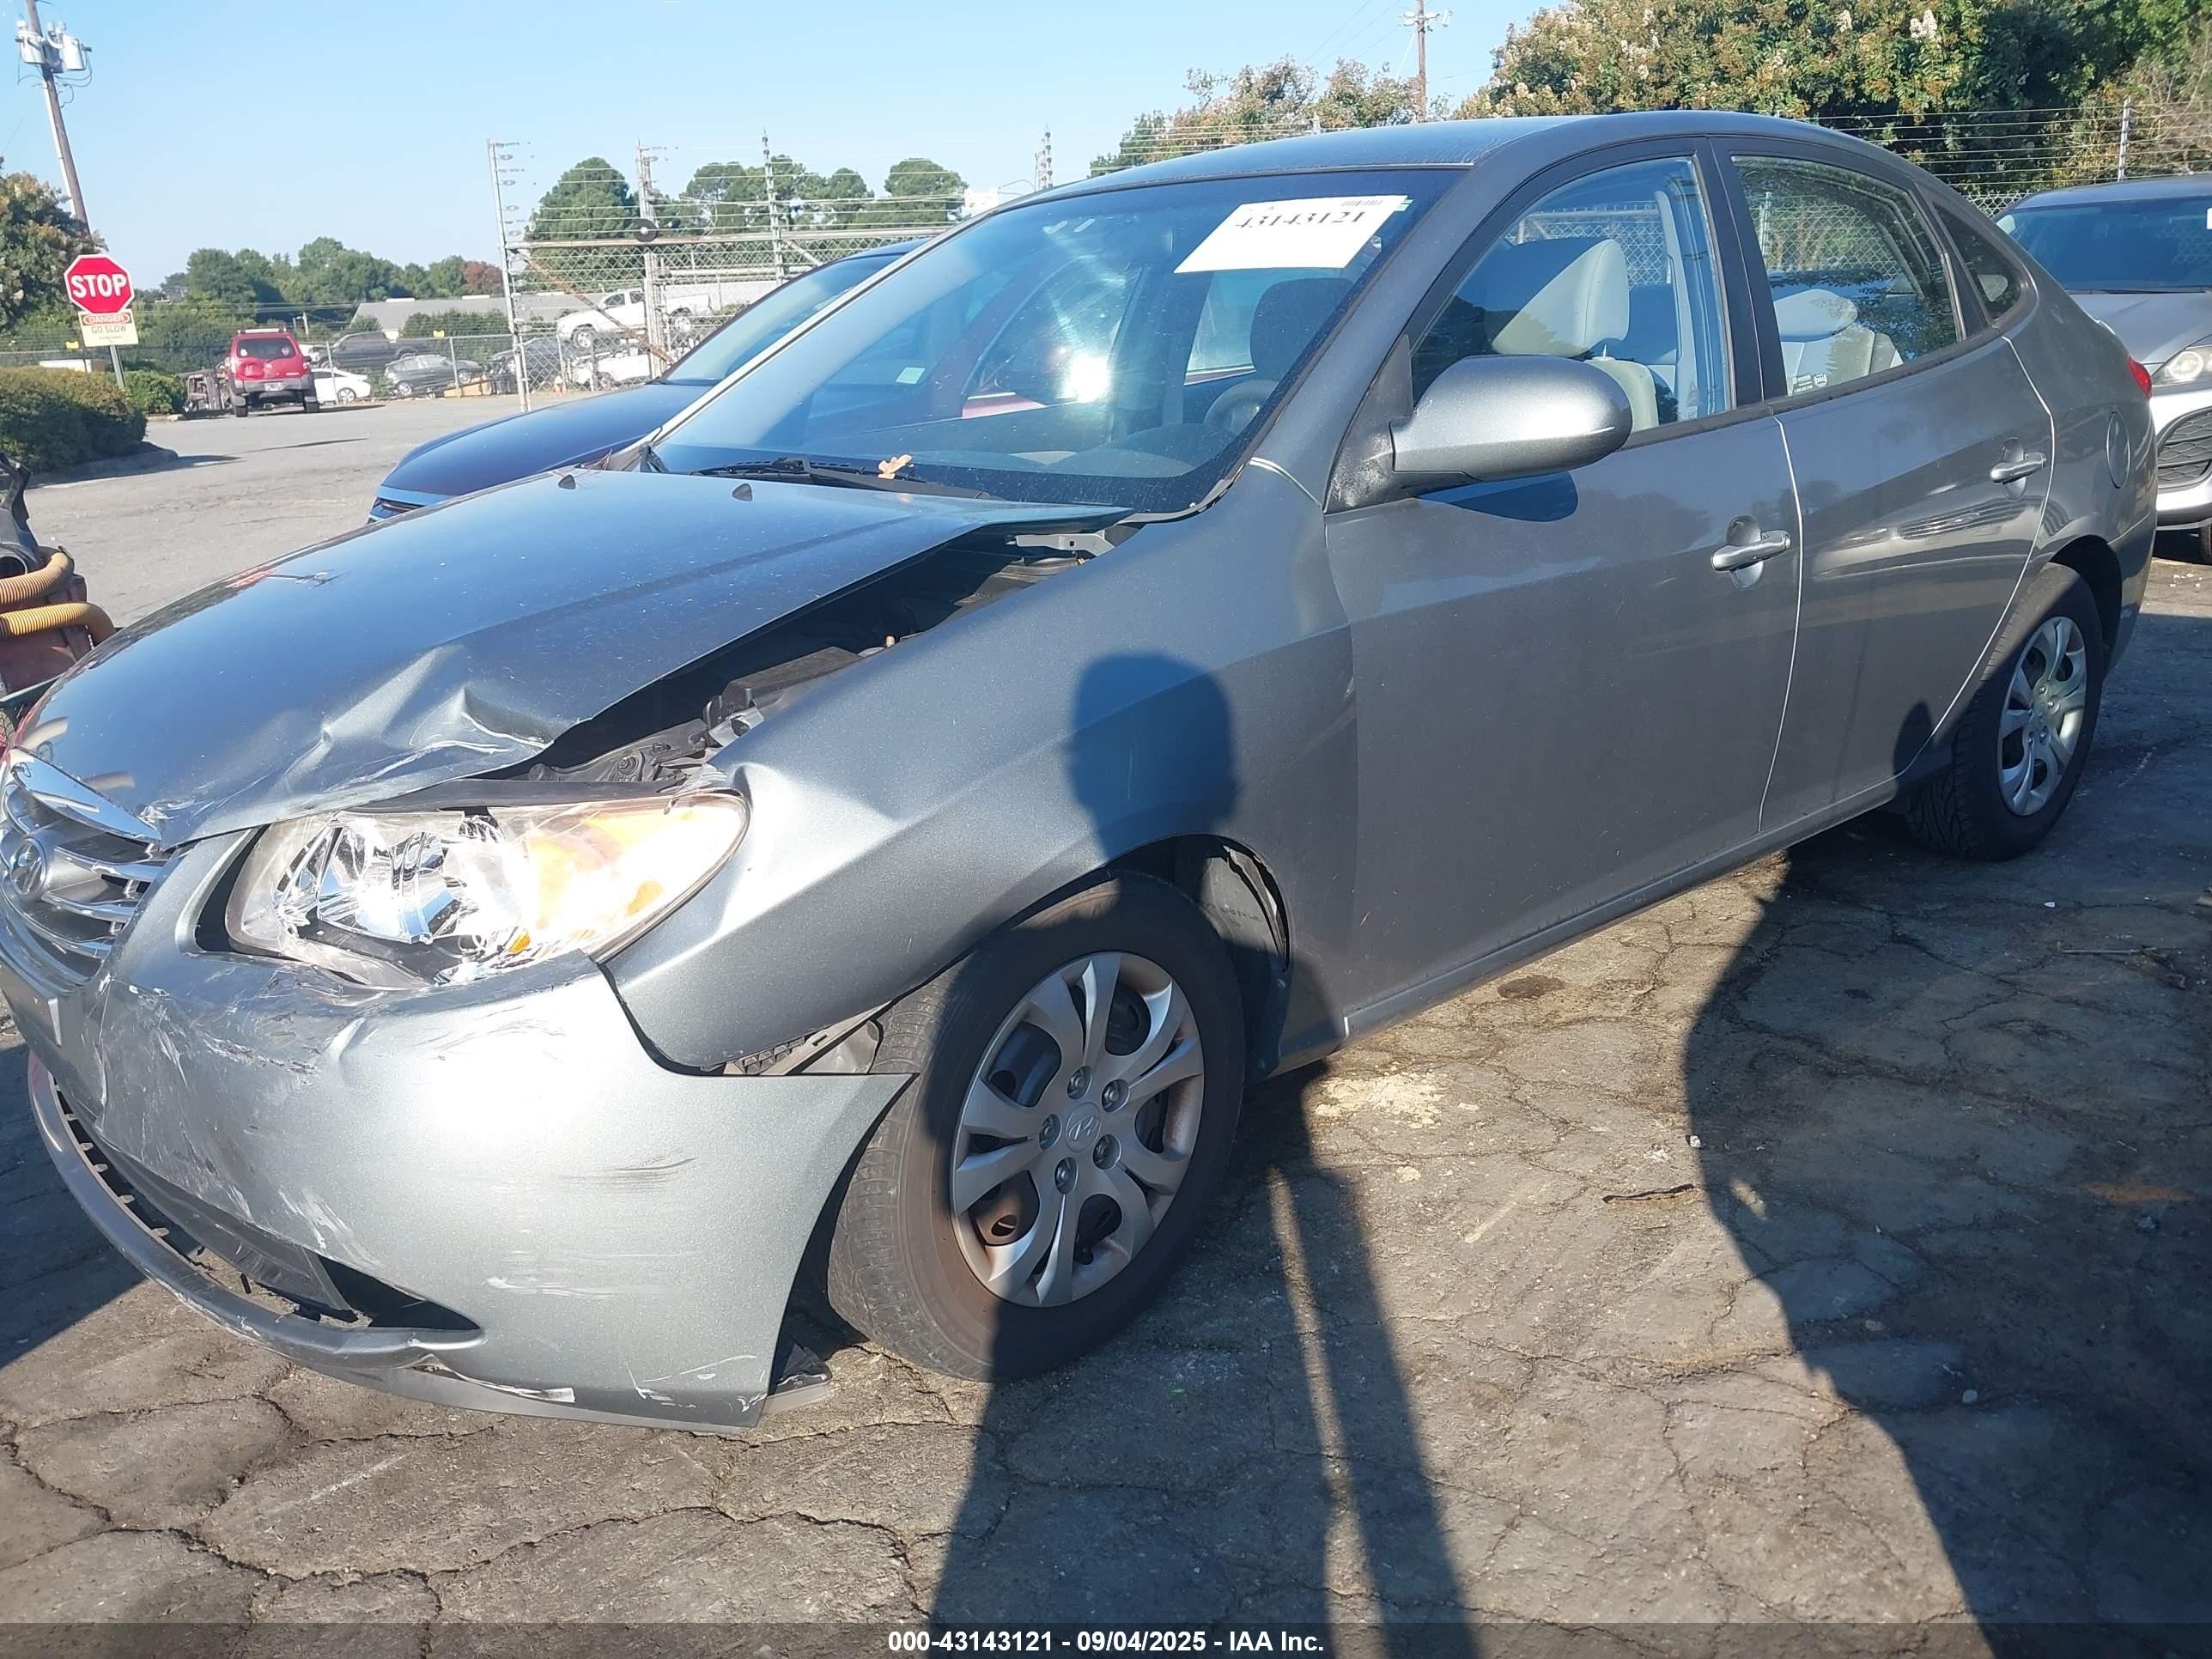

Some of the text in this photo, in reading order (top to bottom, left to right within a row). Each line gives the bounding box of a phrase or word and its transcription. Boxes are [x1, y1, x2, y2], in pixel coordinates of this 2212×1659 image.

[1235, 211, 1366, 229] 43143121
[70, 274, 127, 299] STOP
[88, 314, 125, 324] DANGER
[105, 325, 126, 333] SLOW
